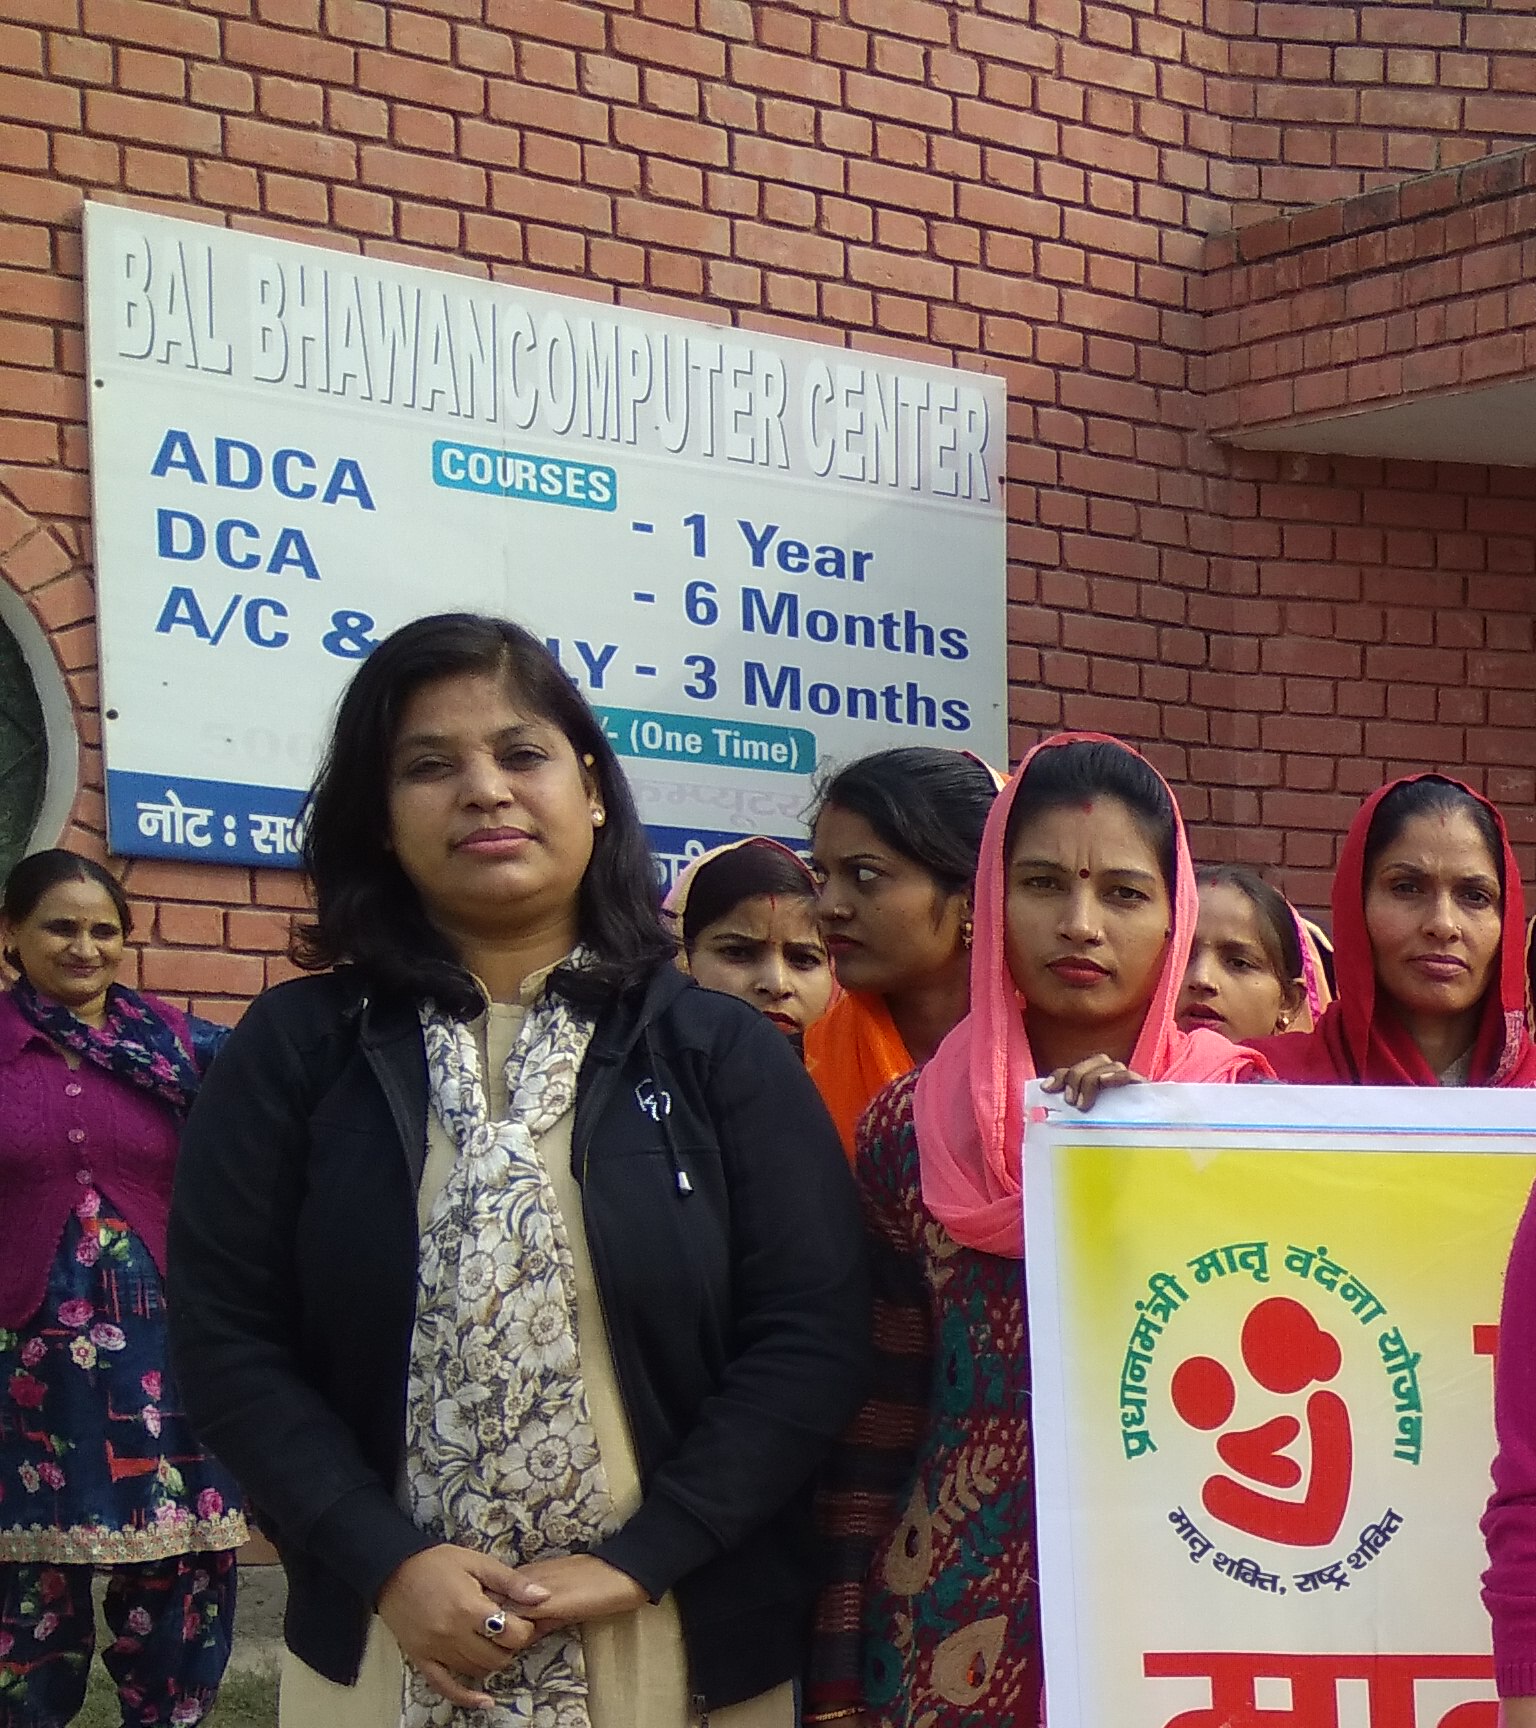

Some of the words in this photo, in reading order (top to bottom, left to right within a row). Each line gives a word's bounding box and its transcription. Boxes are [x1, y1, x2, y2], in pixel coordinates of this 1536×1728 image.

[114, 229, 232, 375] BAL
[803, 357, 991, 503] CENTER
[150, 429, 377, 511] ADCA
[683, 513, 706, 558] 1
[737, 519, 874, 582] Year
[441, 446, 611, 503] COURSES
[156, 508, 322, 580] DCA
[684, 580, 719, 627] 6
[740, 585, 969, 660] Months
[154, 585, 290, 649] A/C
[321, 609, 386, 660] &
[683, 655, 717, 701] 3
[744, 661, 971, 733] Months
[136, 789, 214, 848] नोट
[630, 720, 703, 753] (One
[711, 728, 799, 770] Time)
[1120, 1272, 1190, 1460] प्रधानमंत्री
[1186, 1241, 1270, 1284] मातृ
[1284, 1245, 1388, 1326] वंदना
[1378, 1326, 1423, 1465] योजना
[1168, 1505, 1215, 1564] मातृ
[1293, 1561, 1351, 1592] राष्ट्र
[1346, 1507, 1404, 1570] शक्ति
